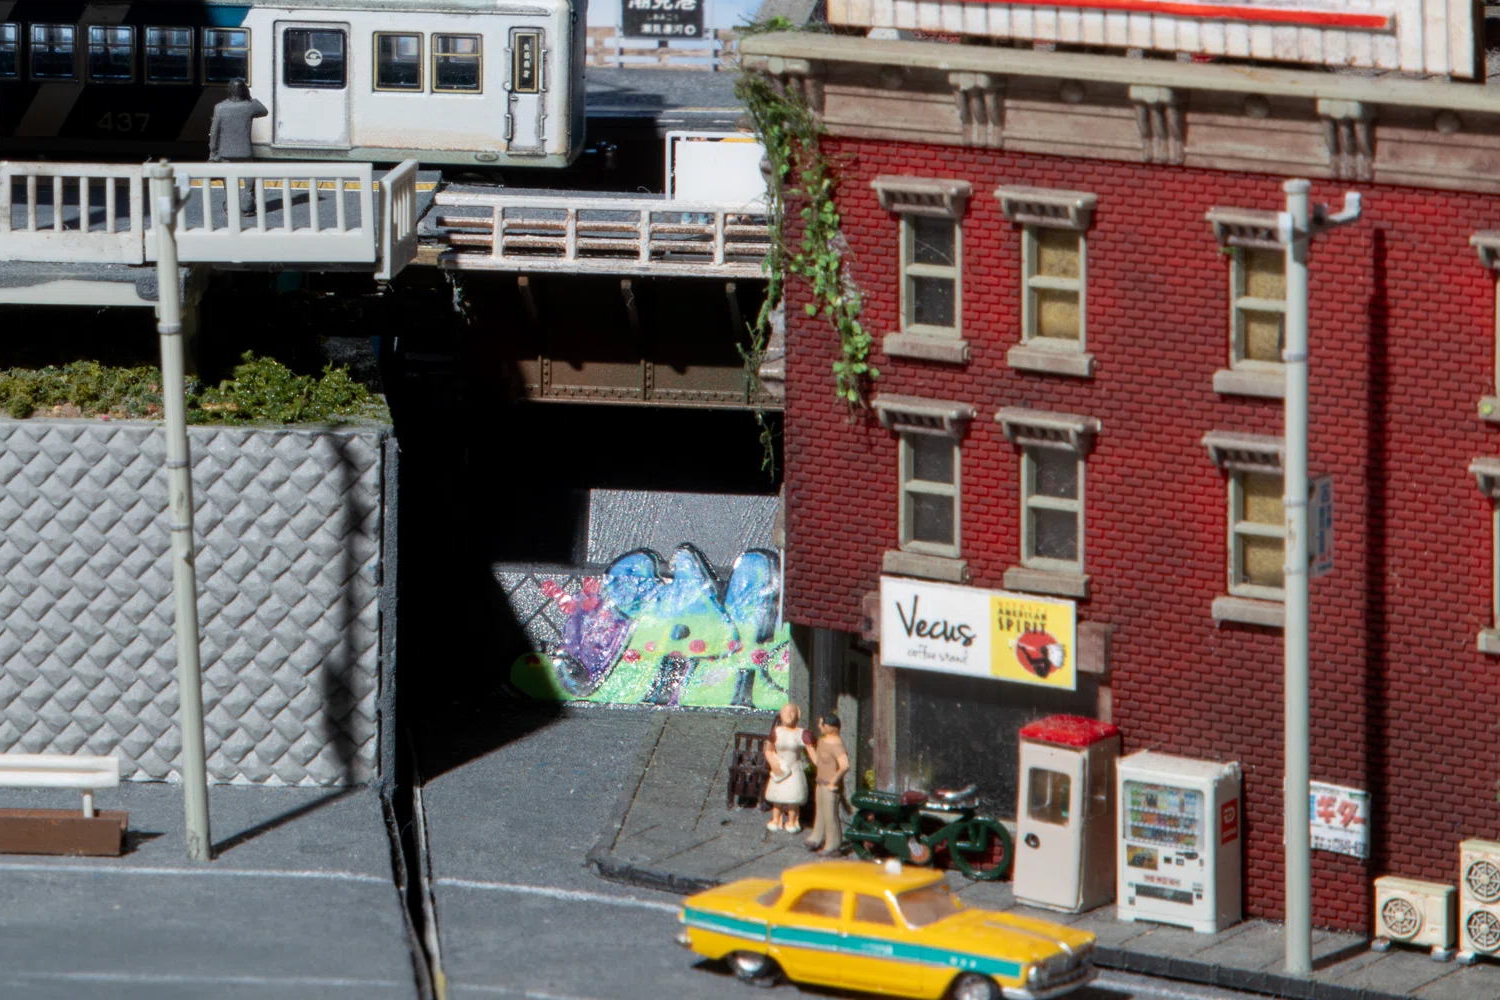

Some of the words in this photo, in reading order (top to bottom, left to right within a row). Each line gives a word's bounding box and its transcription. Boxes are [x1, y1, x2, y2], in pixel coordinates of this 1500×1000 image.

[96, 112, 150, 132] 437
[896, 594, 977, 646] Vecus
[998, 616, 1047, 636] SPIRIT
